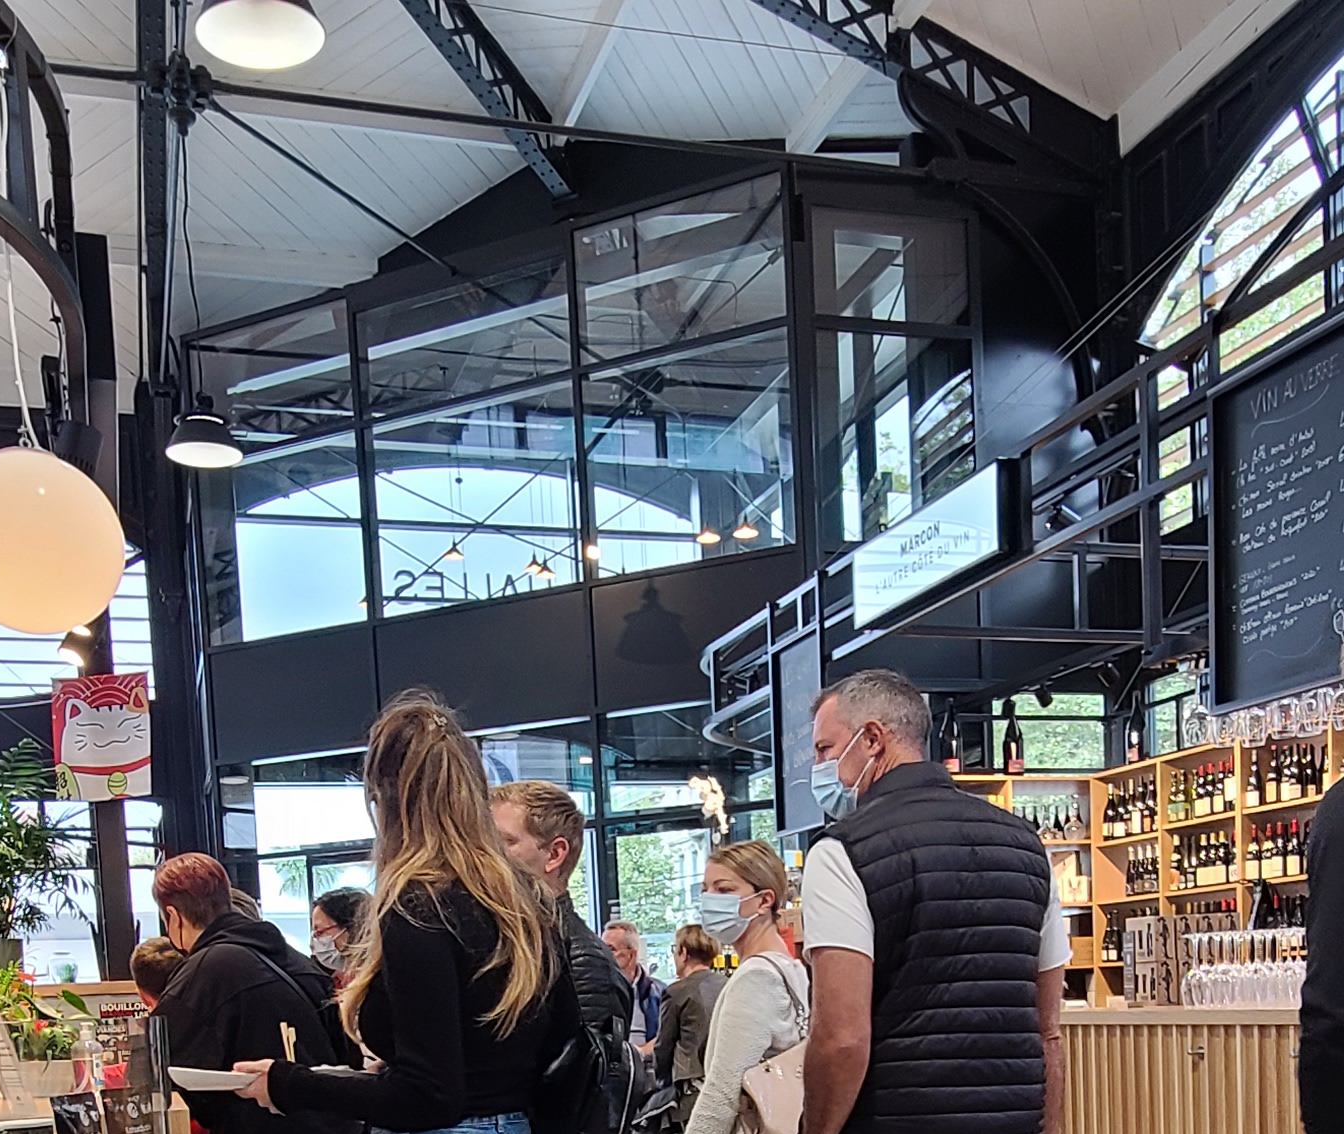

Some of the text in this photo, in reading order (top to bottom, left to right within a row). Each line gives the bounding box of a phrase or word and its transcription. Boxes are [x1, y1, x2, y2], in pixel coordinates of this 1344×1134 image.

[1250, 387, 1277, 419] VIN
[900, 520, 940, 557] MARCON
[937, 541, 949, 558] DU
[953, 529, 969, 549] VIN
[100, 1003, 147, 1012] BOUILLON
